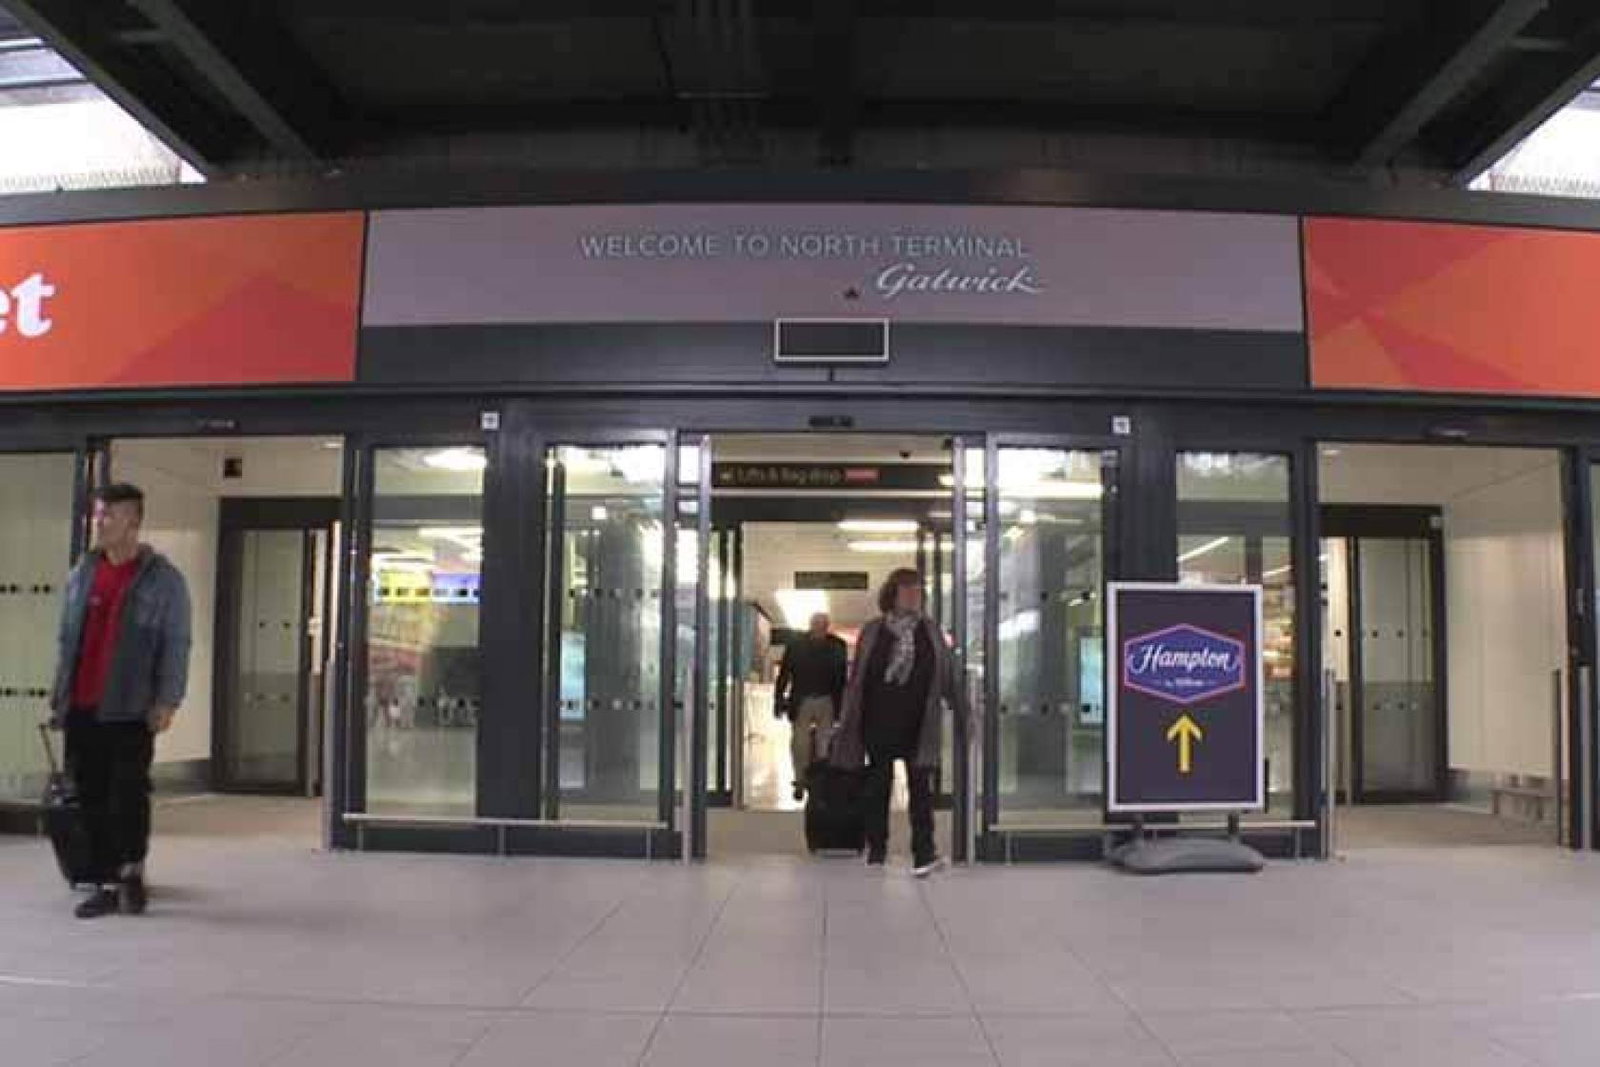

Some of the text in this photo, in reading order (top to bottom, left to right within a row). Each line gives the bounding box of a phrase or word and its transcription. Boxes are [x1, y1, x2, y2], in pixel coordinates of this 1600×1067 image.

[580, 234, 1029, 259] WELCOME TO NORTH TERMINAL
[876, 262, 1043, 297] Gatwick
[0, 272, 54, 336] t
[1130, 644, 1238, 675] Hampton
